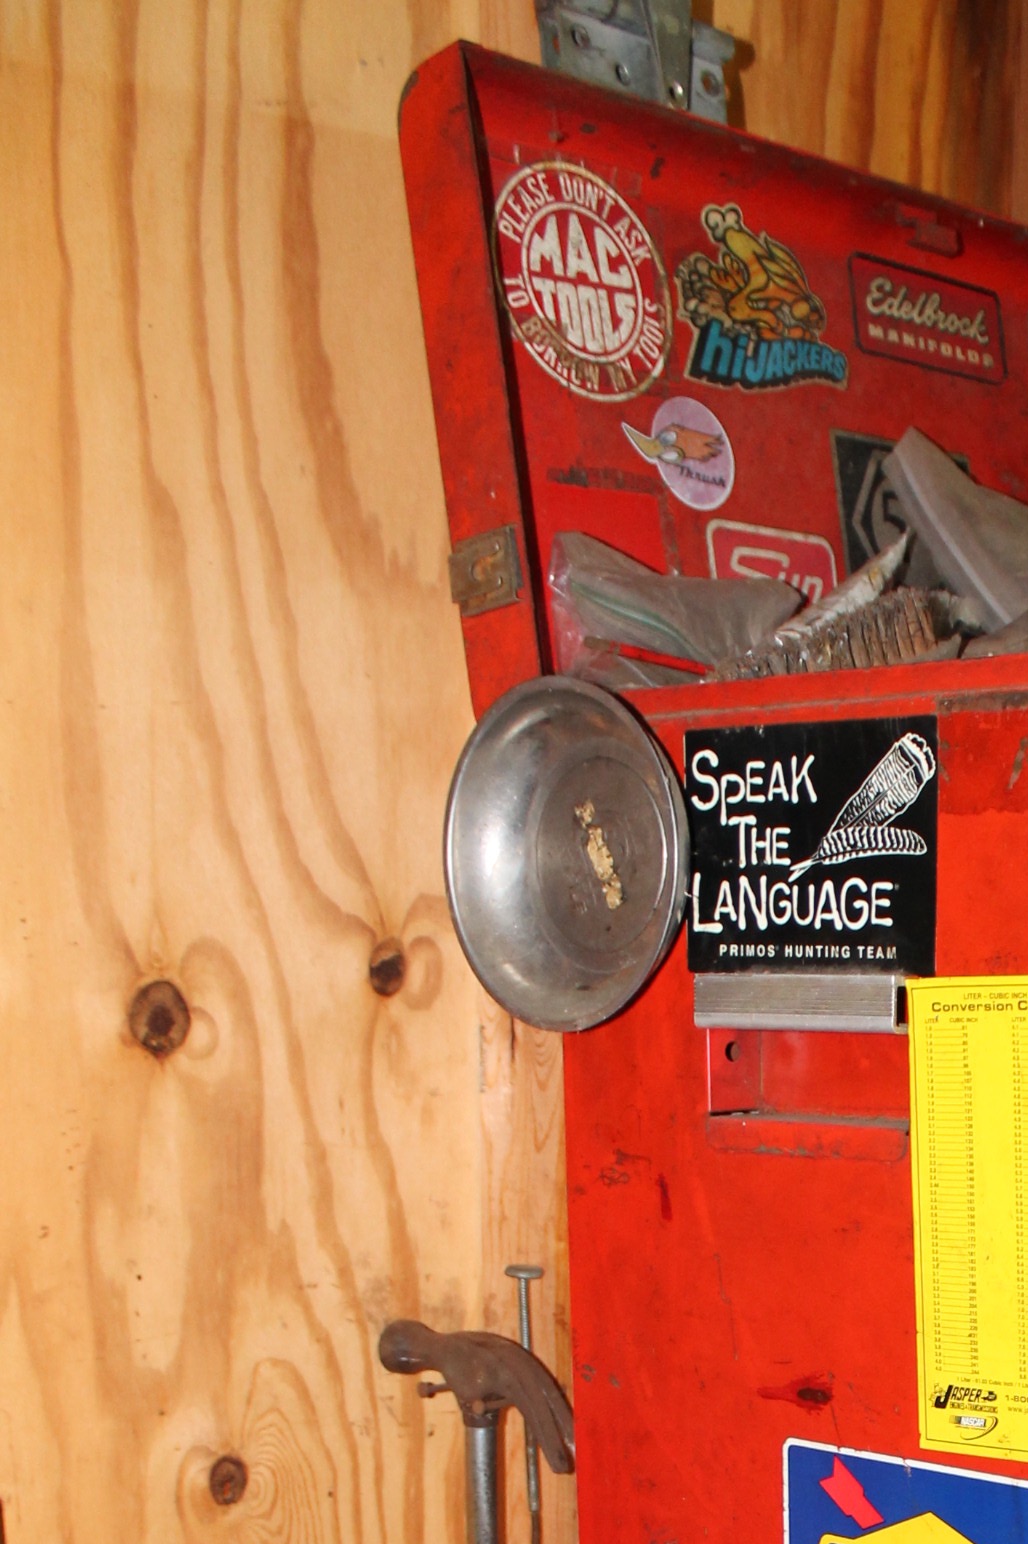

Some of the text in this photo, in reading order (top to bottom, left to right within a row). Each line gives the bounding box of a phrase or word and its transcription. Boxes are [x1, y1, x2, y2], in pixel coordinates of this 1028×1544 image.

[499, 172, 651, 265] PLEASE DON'T ASK
[530, 213, 633, 289] MAC
[503, 273, 529, 309] TO
[634, 298, 665, 369] TOOLS
[531, 276, 636, 353] TOOLS
[866, 277, 989, 344] Edelbrock
[868, 323, 994, 369] MANIFOLDS
[692, 750, 817, 825] SPEAK
[728, 815, 791, 868] THE
[693, 873, 894, 933] LANGUAGE
[720, 944, 897, 960] PRIMOS HUNTING TEAM
[932, 1000, 1013, 1012] Conversion
[934, 1384, 983, 1409] JASPER
